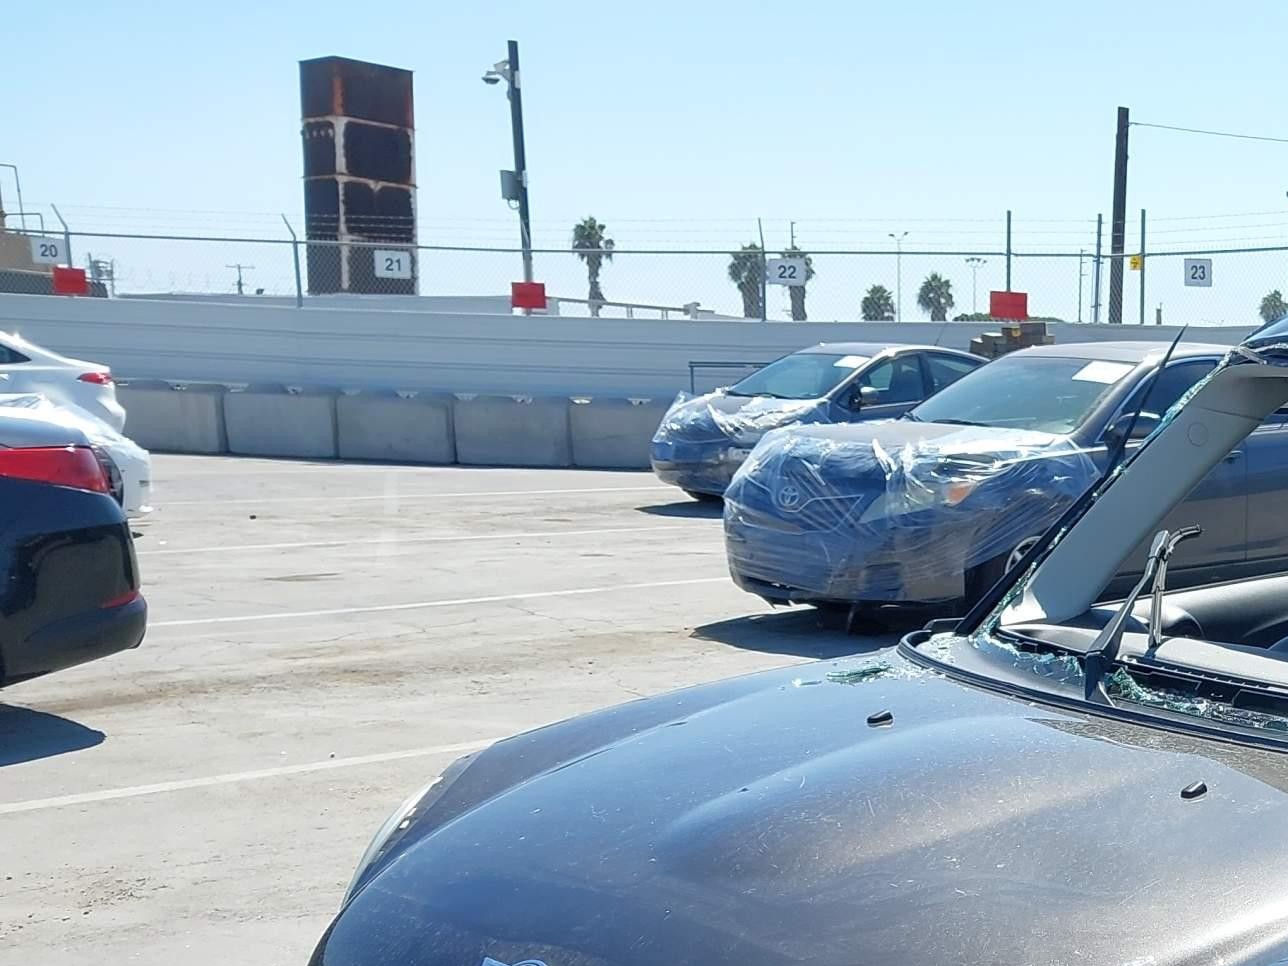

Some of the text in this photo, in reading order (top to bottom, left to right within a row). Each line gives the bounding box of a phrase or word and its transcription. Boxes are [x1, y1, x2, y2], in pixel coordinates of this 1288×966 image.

[39, 243, 59, 258] 20
[384, 257, 402, 272] 21
[777, 264, 798, 280] 22
[1190, 264, 1206, 281] 23
